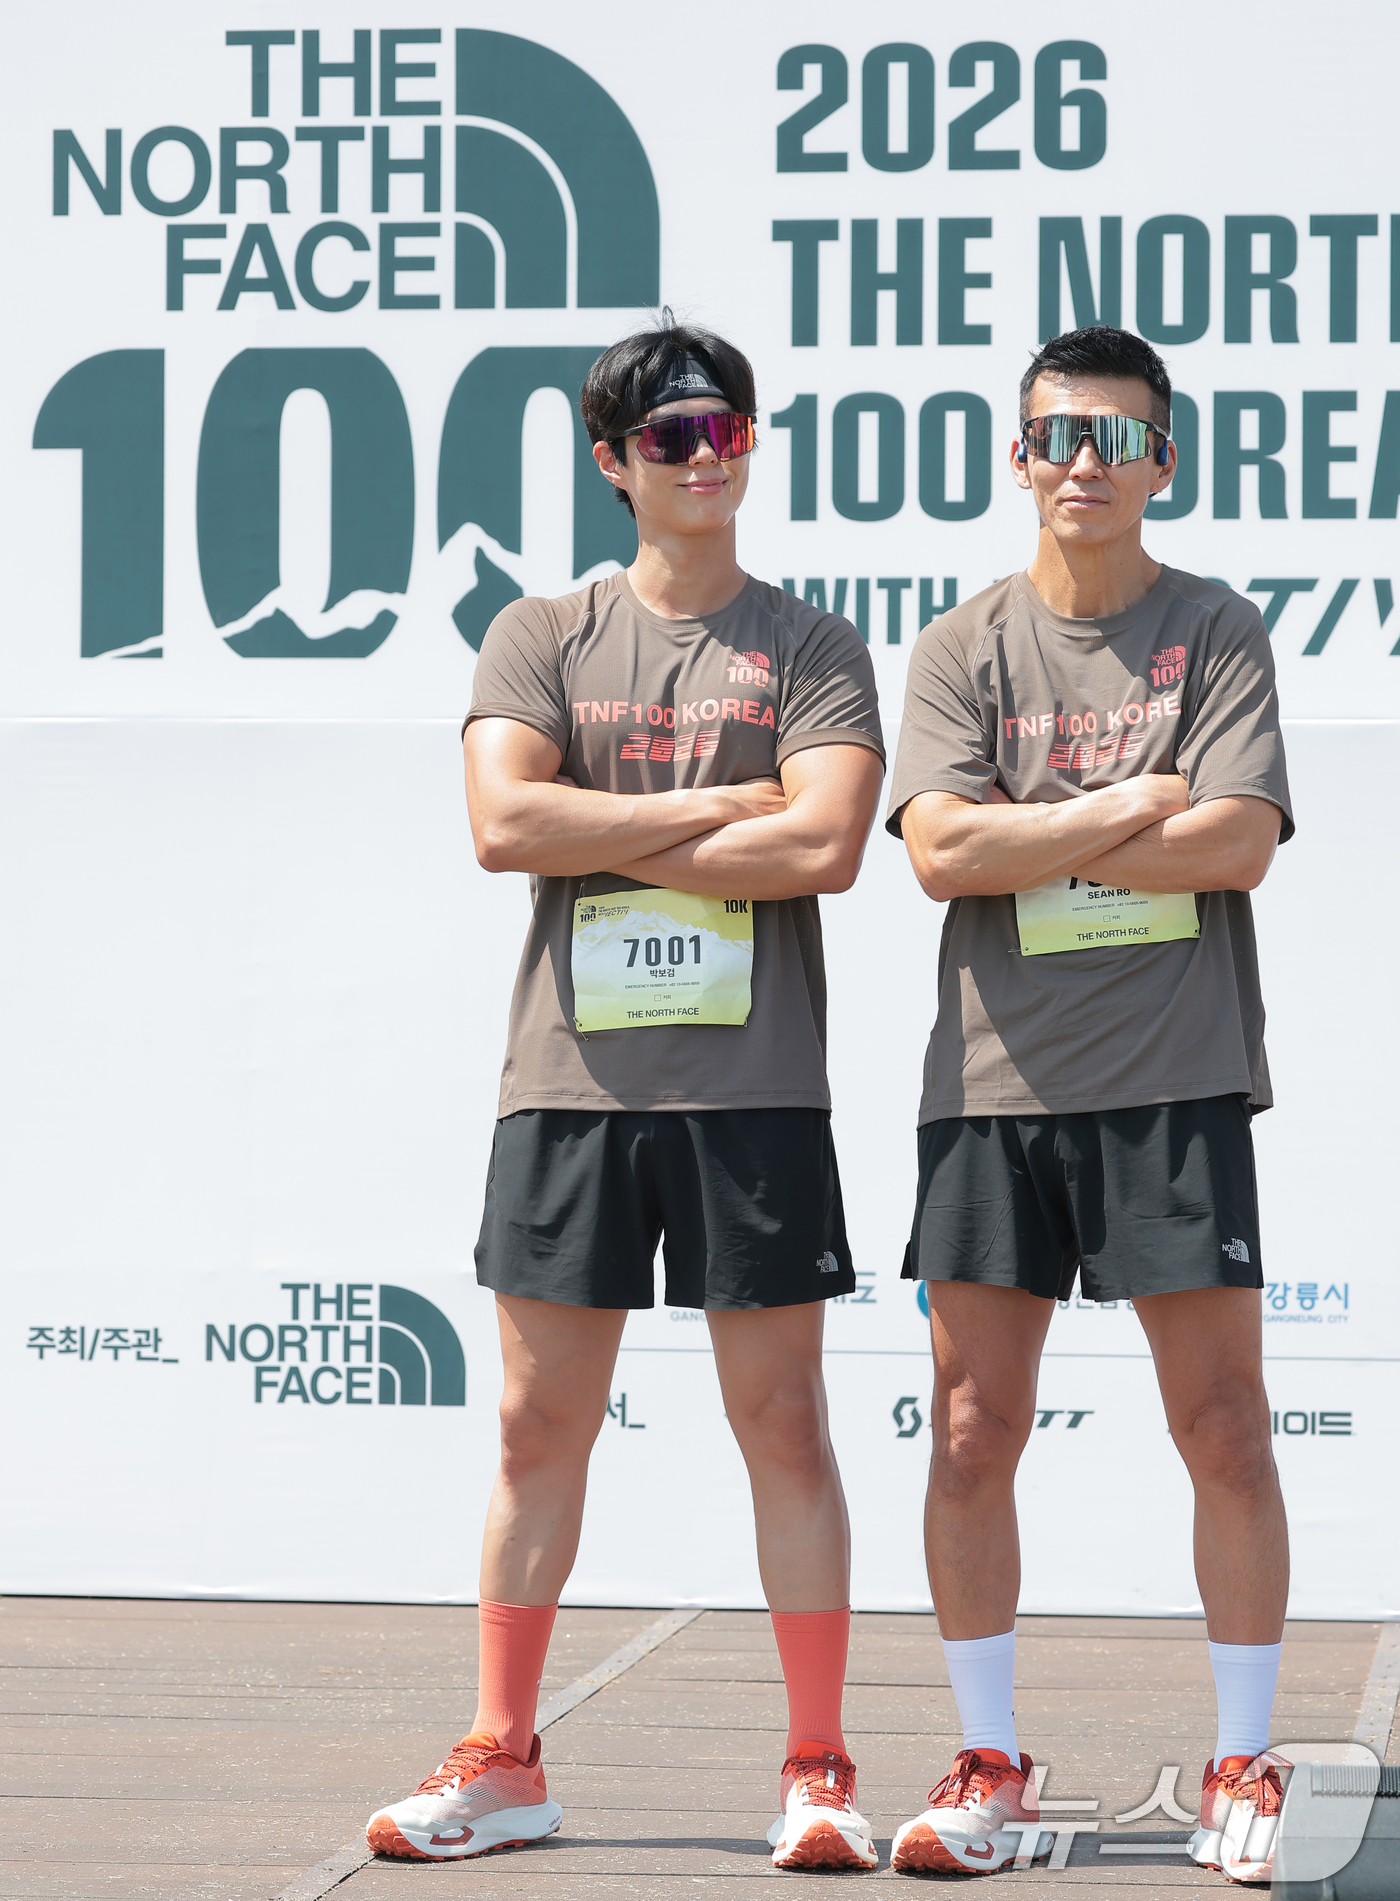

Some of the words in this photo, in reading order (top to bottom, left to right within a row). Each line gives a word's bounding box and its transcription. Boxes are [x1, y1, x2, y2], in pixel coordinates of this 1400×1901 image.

[225, 28, 442, 117] THE
[776, 40, 1108, 173] 2026
[52, 125, 442, 216] NORTH
[165, 220, 441, 312] FACE
[771, 217, 993, 347] THE
[1038, 213, 1400, 345] NORT
[770, 391, 992, 522] 100
[727, 666, 769, 688] 100
[1150, 659, 1185, 687] 100
[573, 700, 676, 729] TNF100
[682, 698, 775, 730] KOREA
[1004, 711, 1097, 739] TNF100
[1106, 693, 1182, 730] KORE
[620, 730, 720, 762] 2026
[723, 899, 748, 914] 10K
[1087, 889, 1115, 900] SEAN
[1117, 888, 1131, 897] RO
[1077, 932, 1094, 942] THE
[1095, 929, 1127, 940] NORTH
[1128, 927, 1149, 937] FACE
[623, 935, 701, 968] 7001
[650, 968, 675, 979] 박보검
[627, 1011, 644, 1019] THE
[645, 1009, 675, 1018] NORTH
[677, 1007, 700, 1016] FACE
[280, 1282, 374, 1322] THE
[1265, 1282, 1348, 1310] 강릉시
[1263, 1314, 1323, 1323] GANGNEUNG
[1327, 1314, 1349, 1323] CITY
[205, 1324, 374, 1363] NORTH
[254, 1366, 374, 1404] FACE
